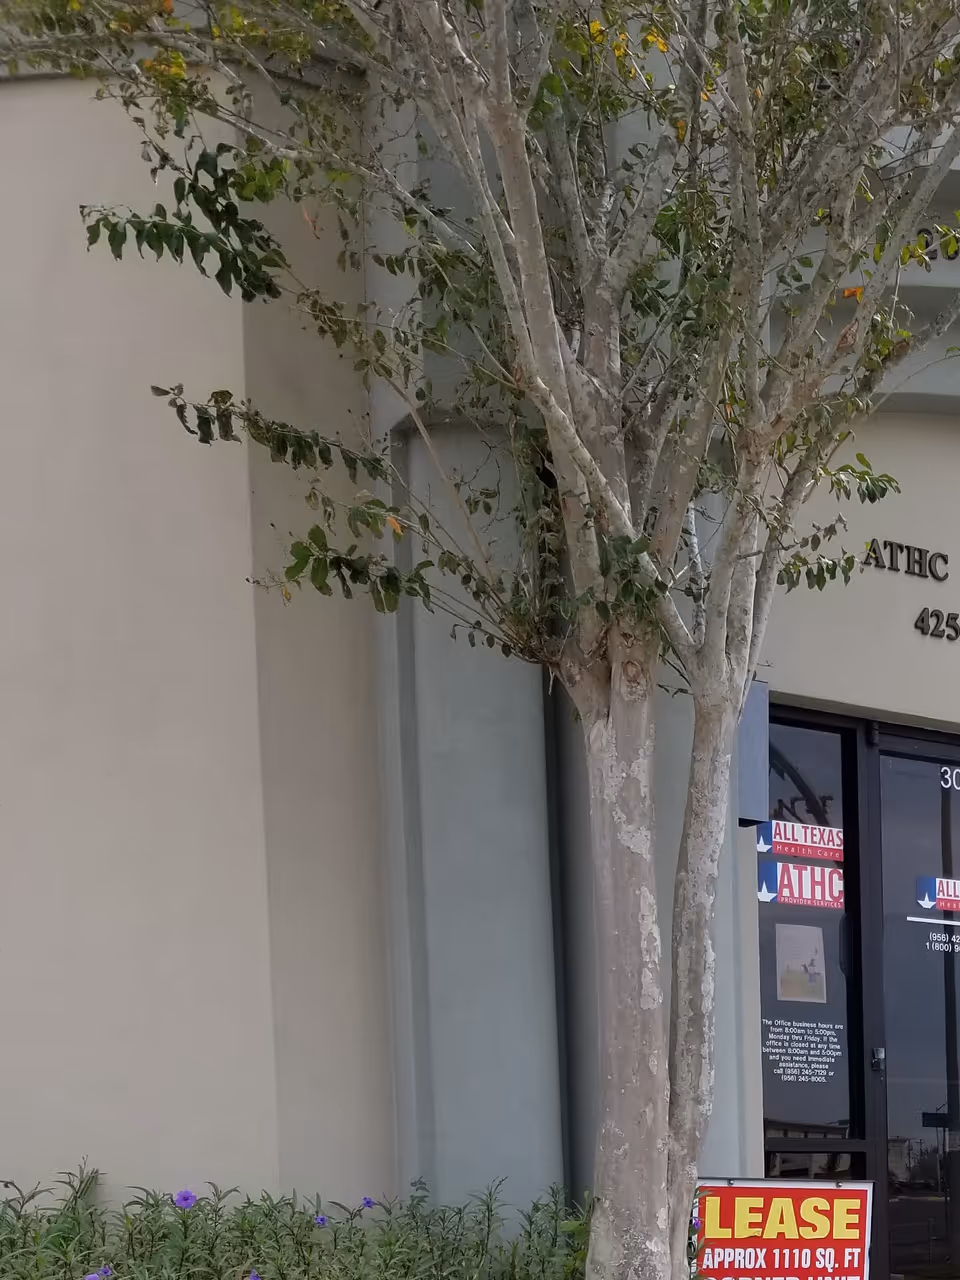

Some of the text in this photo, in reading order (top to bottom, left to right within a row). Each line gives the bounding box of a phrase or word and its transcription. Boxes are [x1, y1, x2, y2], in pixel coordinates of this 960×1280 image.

[863, 538, 949, 582] ATHC
[773, 821, 844, 848] ALL TEXAS
[776, 844, 840, 859] Health Care
[779, 863, 844, 902] ATHC
[937, 879, 960, 899] ALL
[781, 896, 841, 908] PROVIDER SERVICES
[929, 931, 949, 943] (956)
[931, 942, 951, 953] (800)
[762, 1018, 772, 1026] The
[774, 1019, 791, 1027] Office
[792, 1020, 816, 1028] business
[768, 1033, 789, 1041] Monday
[784, 1027, 806, 1035] 8:00am
[762, 1046, 786, 1054] between
[810, 1048, 820, 1056] and
[817, 1043, 828, 1051] any
[781, 1055, 792, 1063] you
[811, 1062, 829, 1070] please
[704, 1196, 861, 1240] LEASE
[702, 1247, 861, 1273] APPROX 1110 SQ. FT
